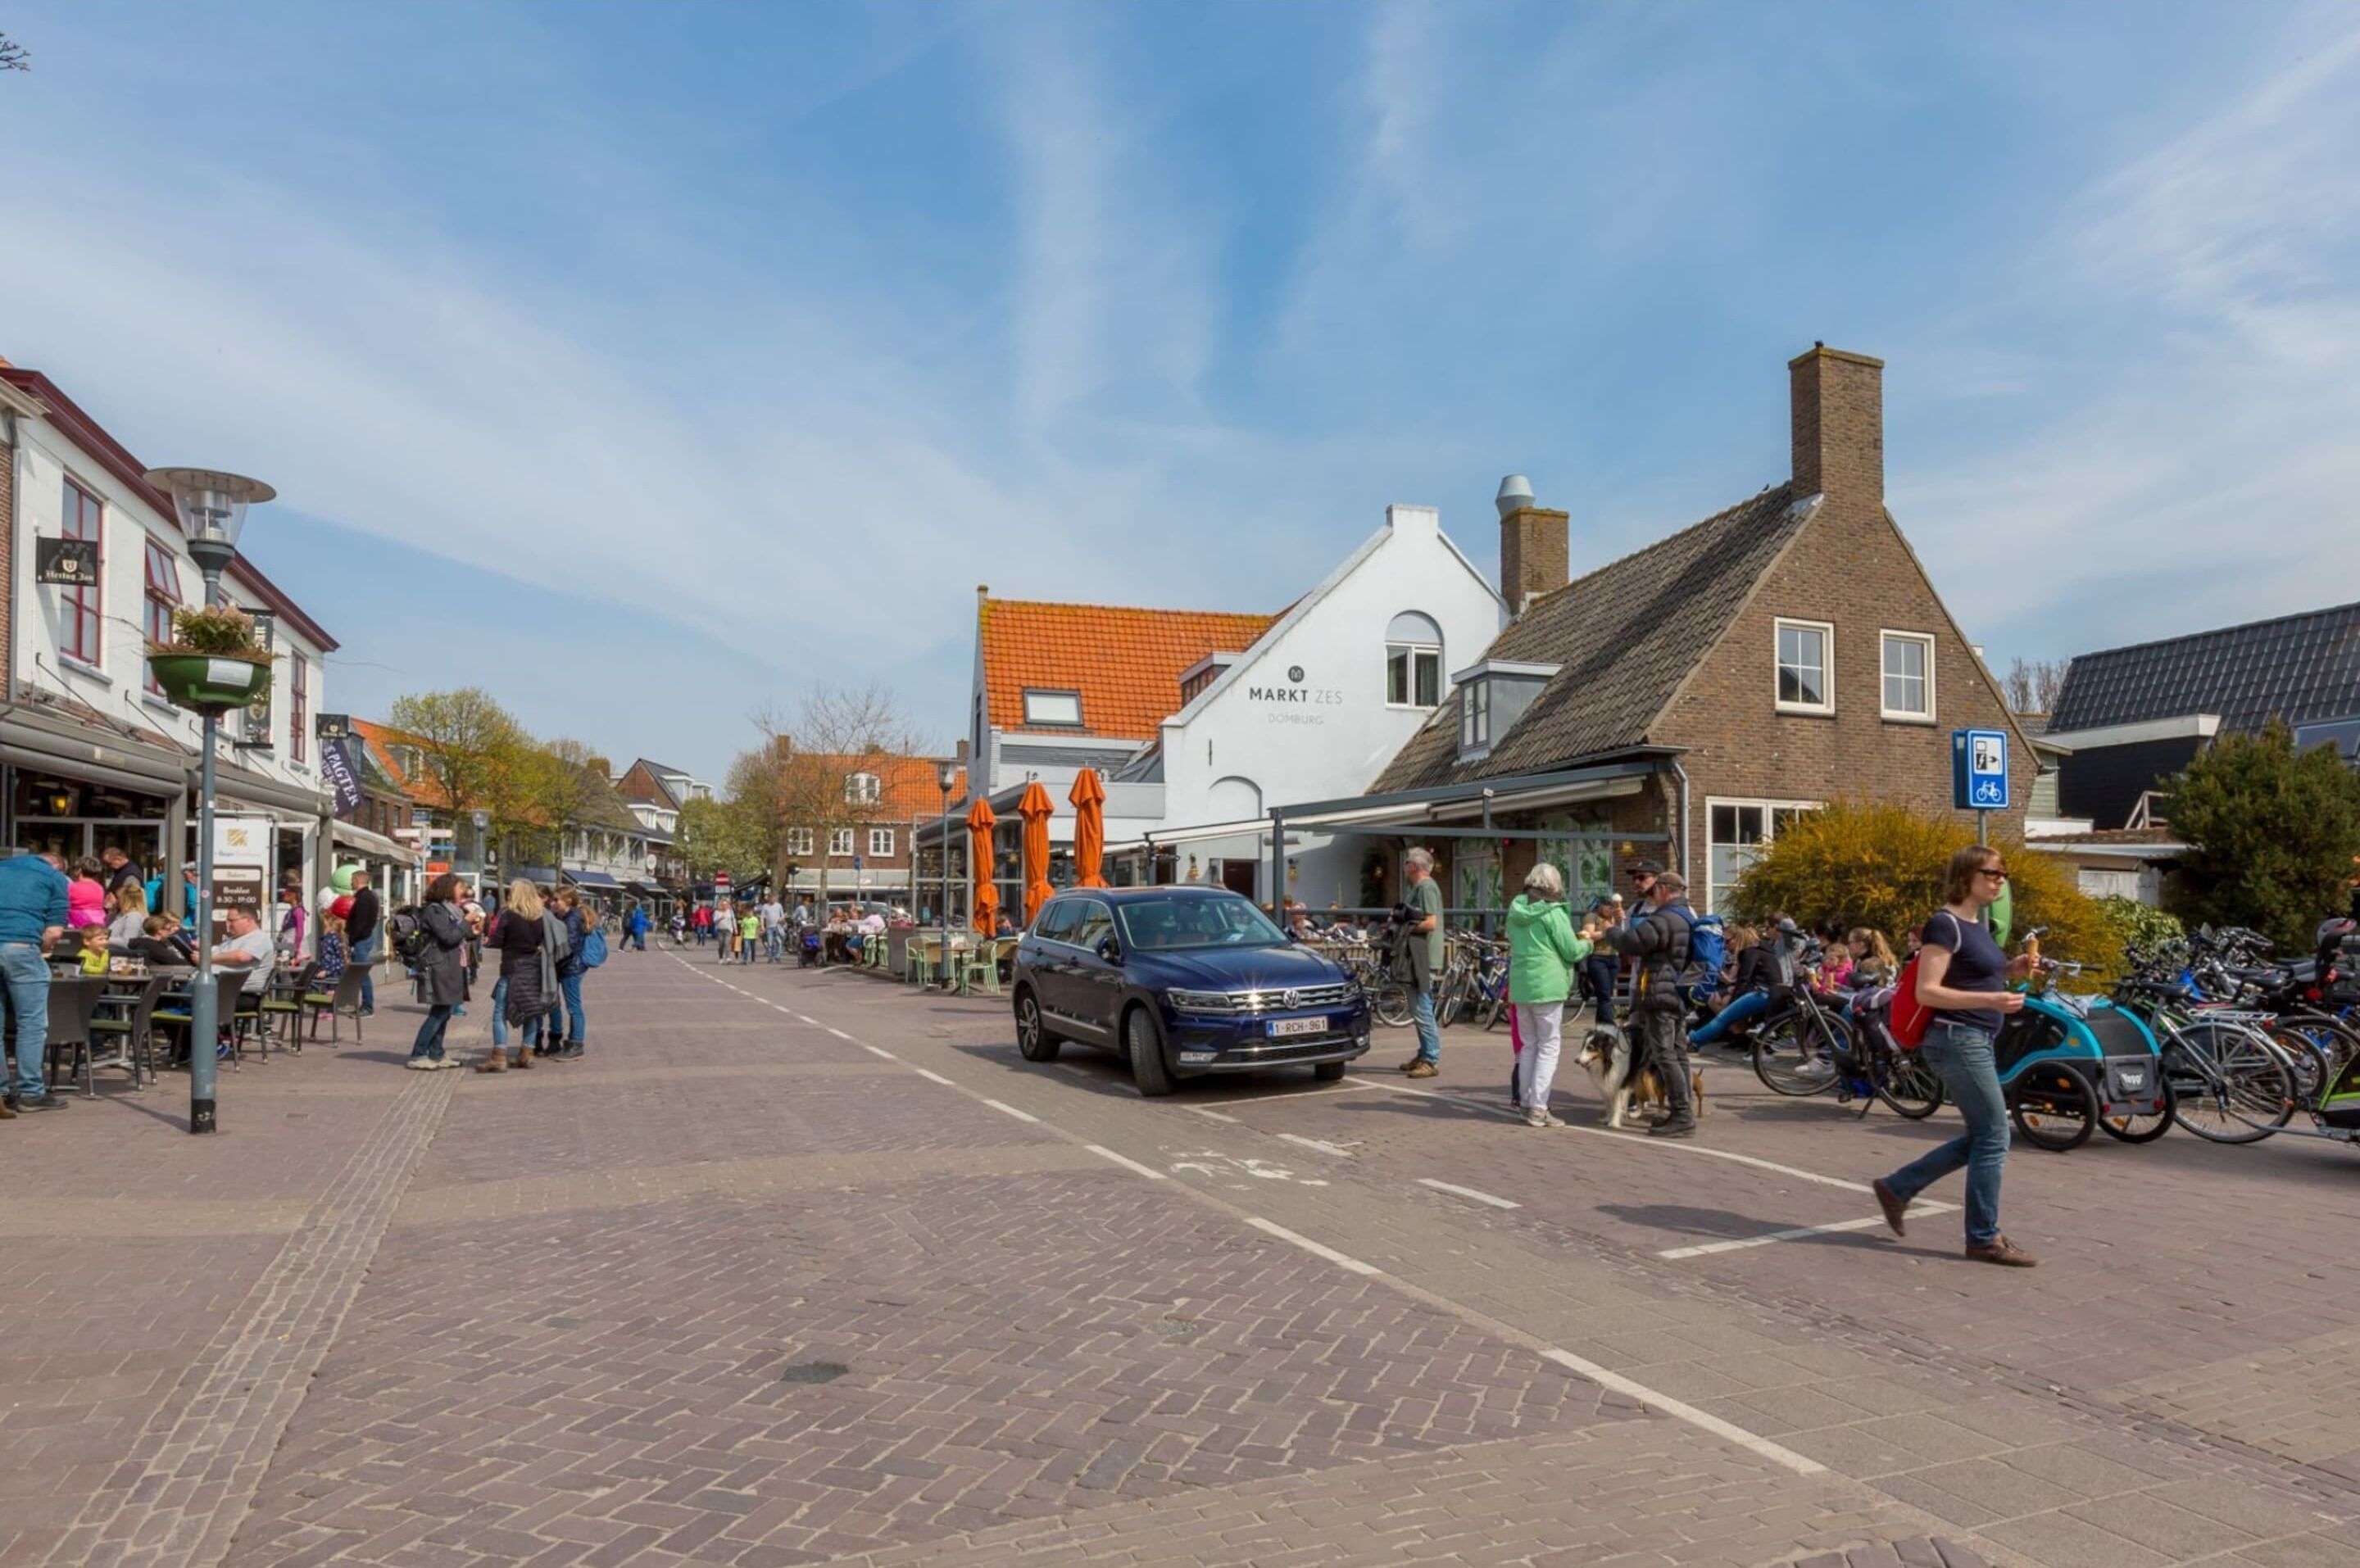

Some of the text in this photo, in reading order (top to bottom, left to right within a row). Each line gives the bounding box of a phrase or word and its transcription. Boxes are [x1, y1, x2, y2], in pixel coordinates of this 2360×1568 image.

[1249, 687, 1343, 705] MARKT ZES
[1268, 712, 1324, 726] DOMBURG
[327, 753, 360, 807] PAGTER
